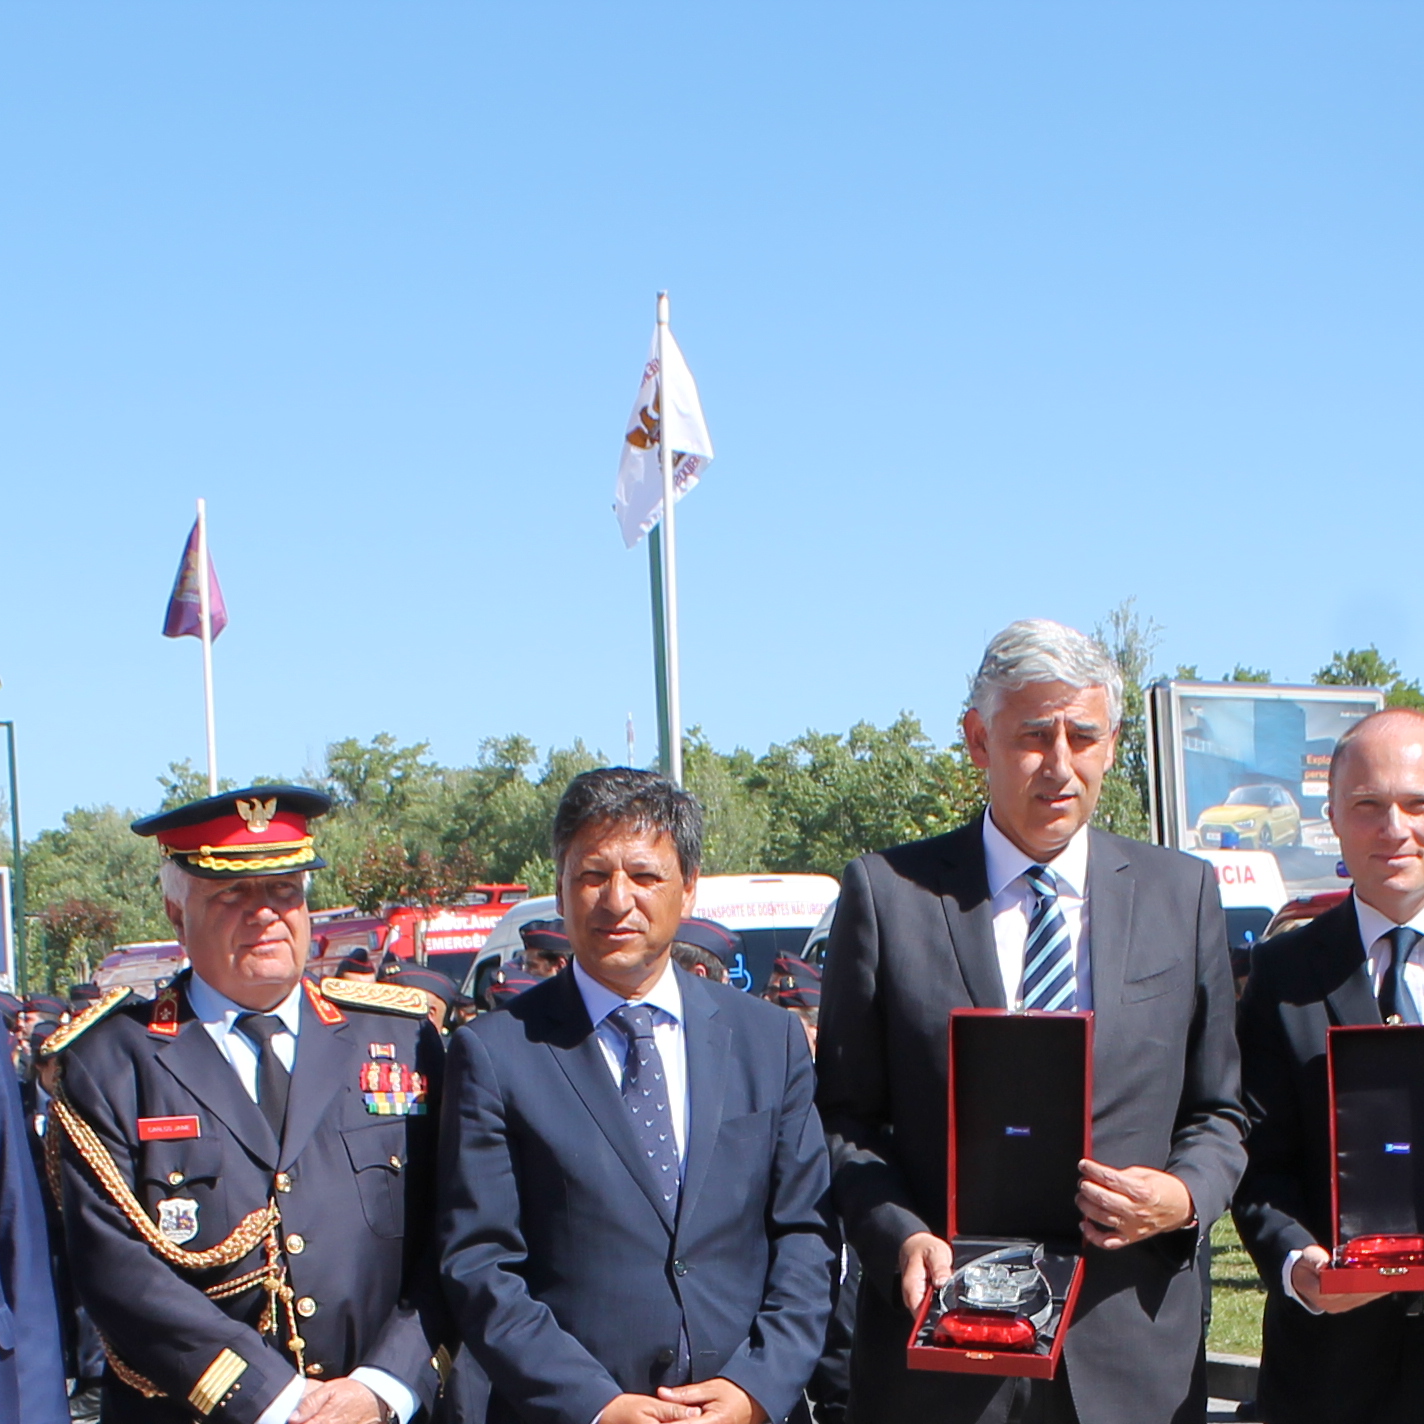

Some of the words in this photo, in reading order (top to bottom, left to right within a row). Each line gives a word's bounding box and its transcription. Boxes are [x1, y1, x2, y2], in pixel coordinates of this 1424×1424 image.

[696, 902, 746, 918] TRANSPORTE
[758, 901, 789, 917] DOENTES
[808, 902, 830, 916] URGEN
[427, 915, 503, 932] AMBULÂNC
